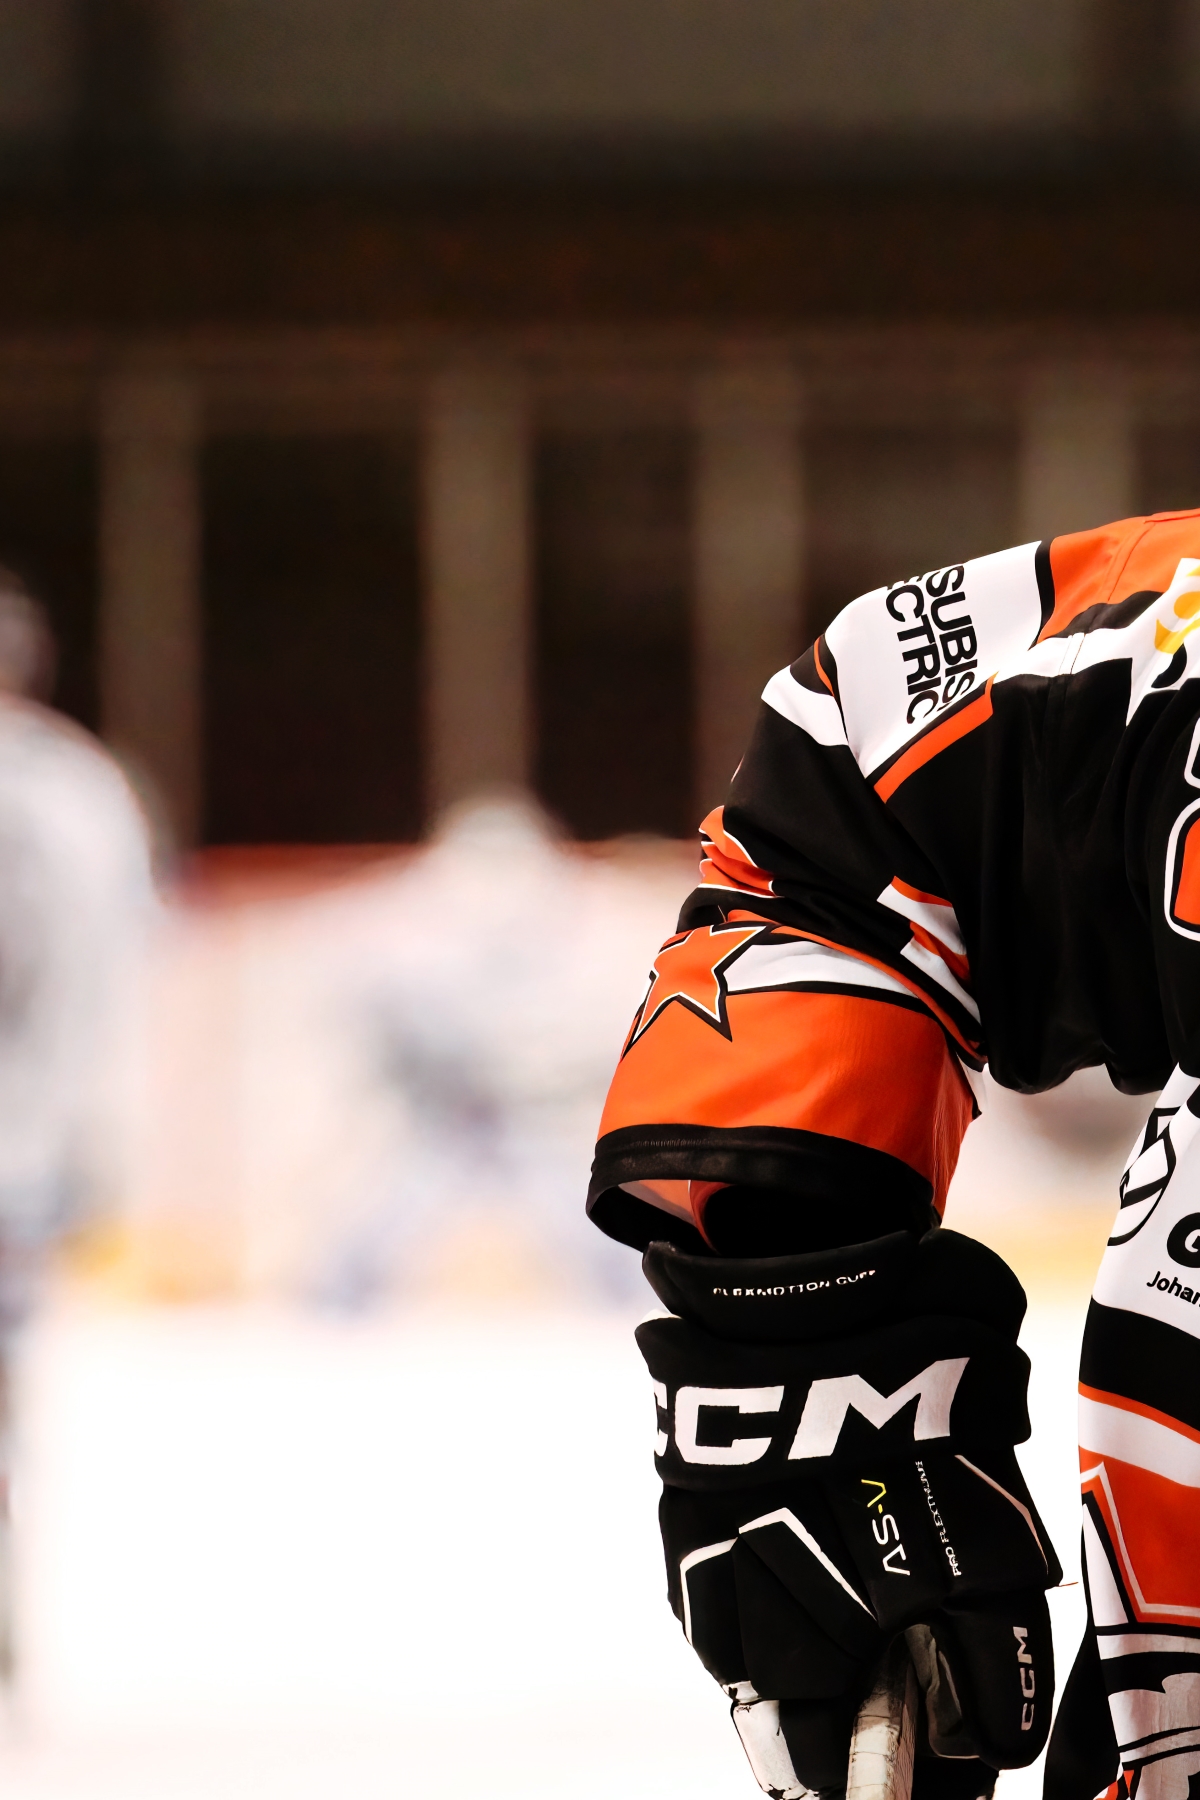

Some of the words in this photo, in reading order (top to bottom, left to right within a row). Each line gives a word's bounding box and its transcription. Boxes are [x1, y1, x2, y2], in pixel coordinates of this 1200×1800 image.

[885, 584, 942, 724] CTRIC
[926, 564, 978, 712] SUBIS
[653, 1357, 970, 1466] CCM
[1011, 1625, 1034, 1731] CCM
